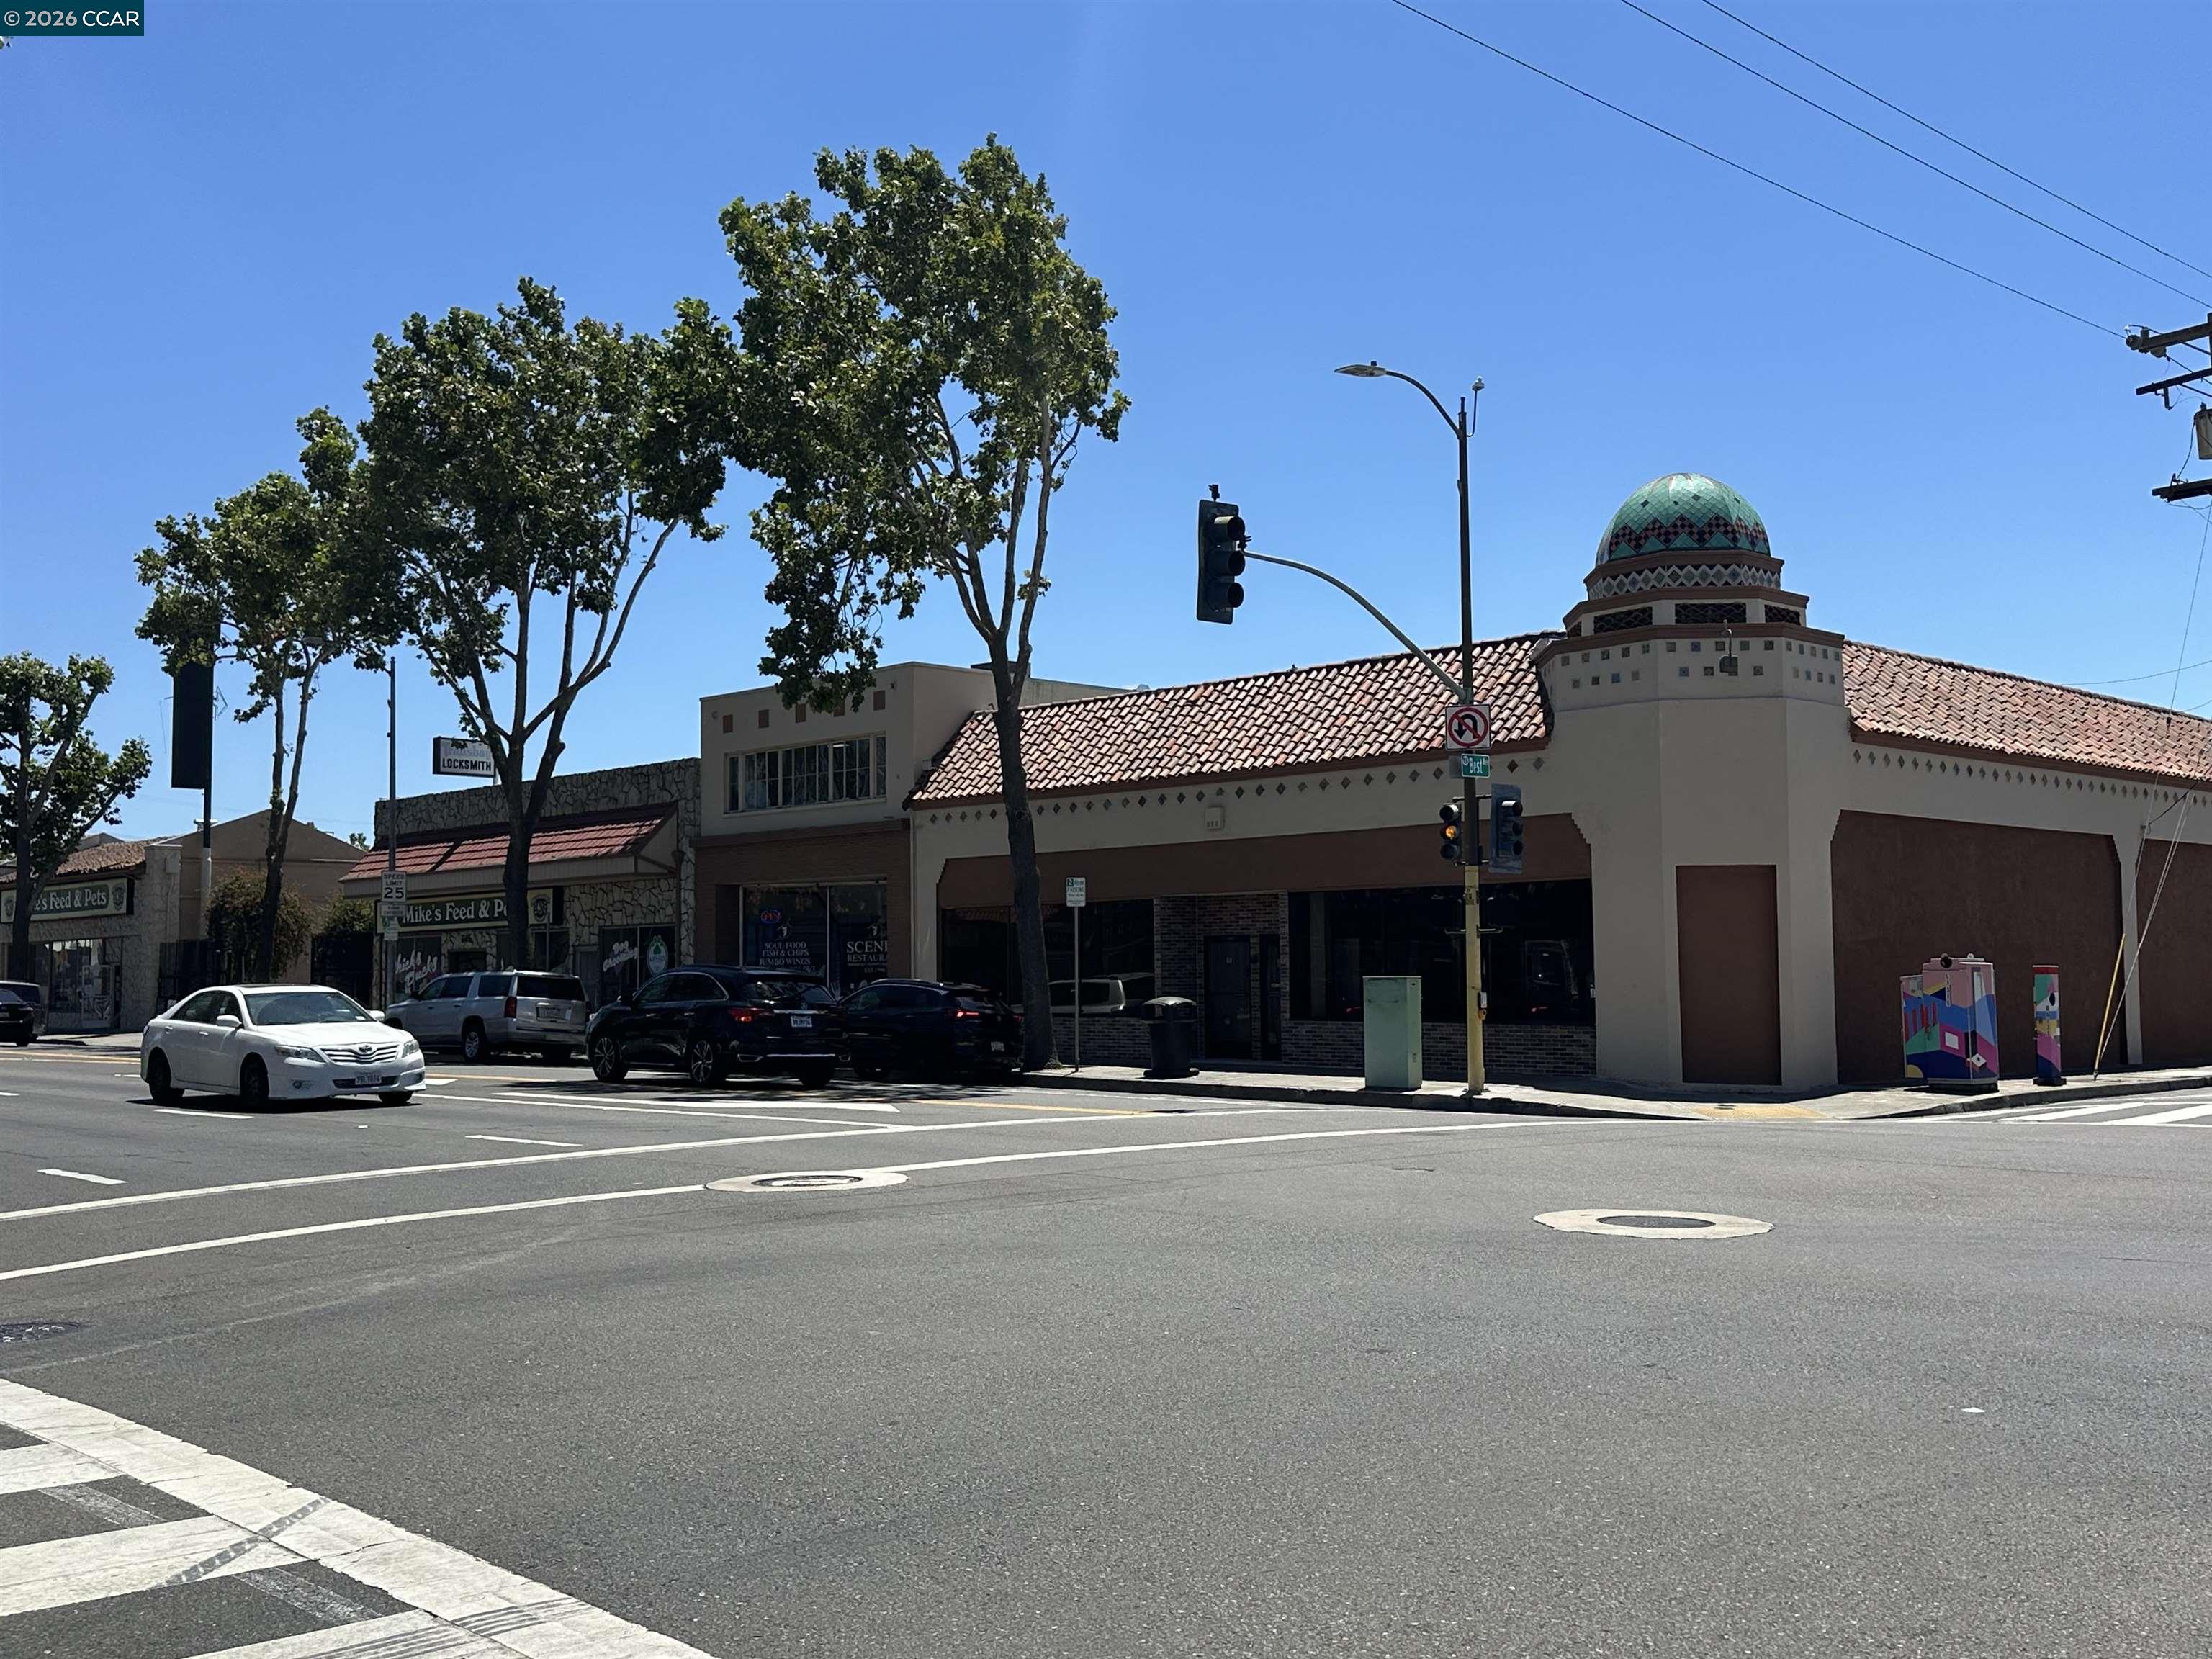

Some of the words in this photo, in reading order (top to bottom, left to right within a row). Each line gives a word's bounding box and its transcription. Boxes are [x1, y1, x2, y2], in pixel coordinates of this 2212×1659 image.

[442, 758, 491, 771] LOCKSMITH
[1469, 756, 1483, 774] Best
[50, 891, 71, 909] Feed
[74, 890, 81, 908] &
[84, 888, 107, 906] Pets
[384, 887, 404, 899] 25
[402, 903, 442, 923] Mike's
[445, 902, 475, 921] Feed
[478, 900, 490, 918] &
[395, 950, 421, 974] hicks
